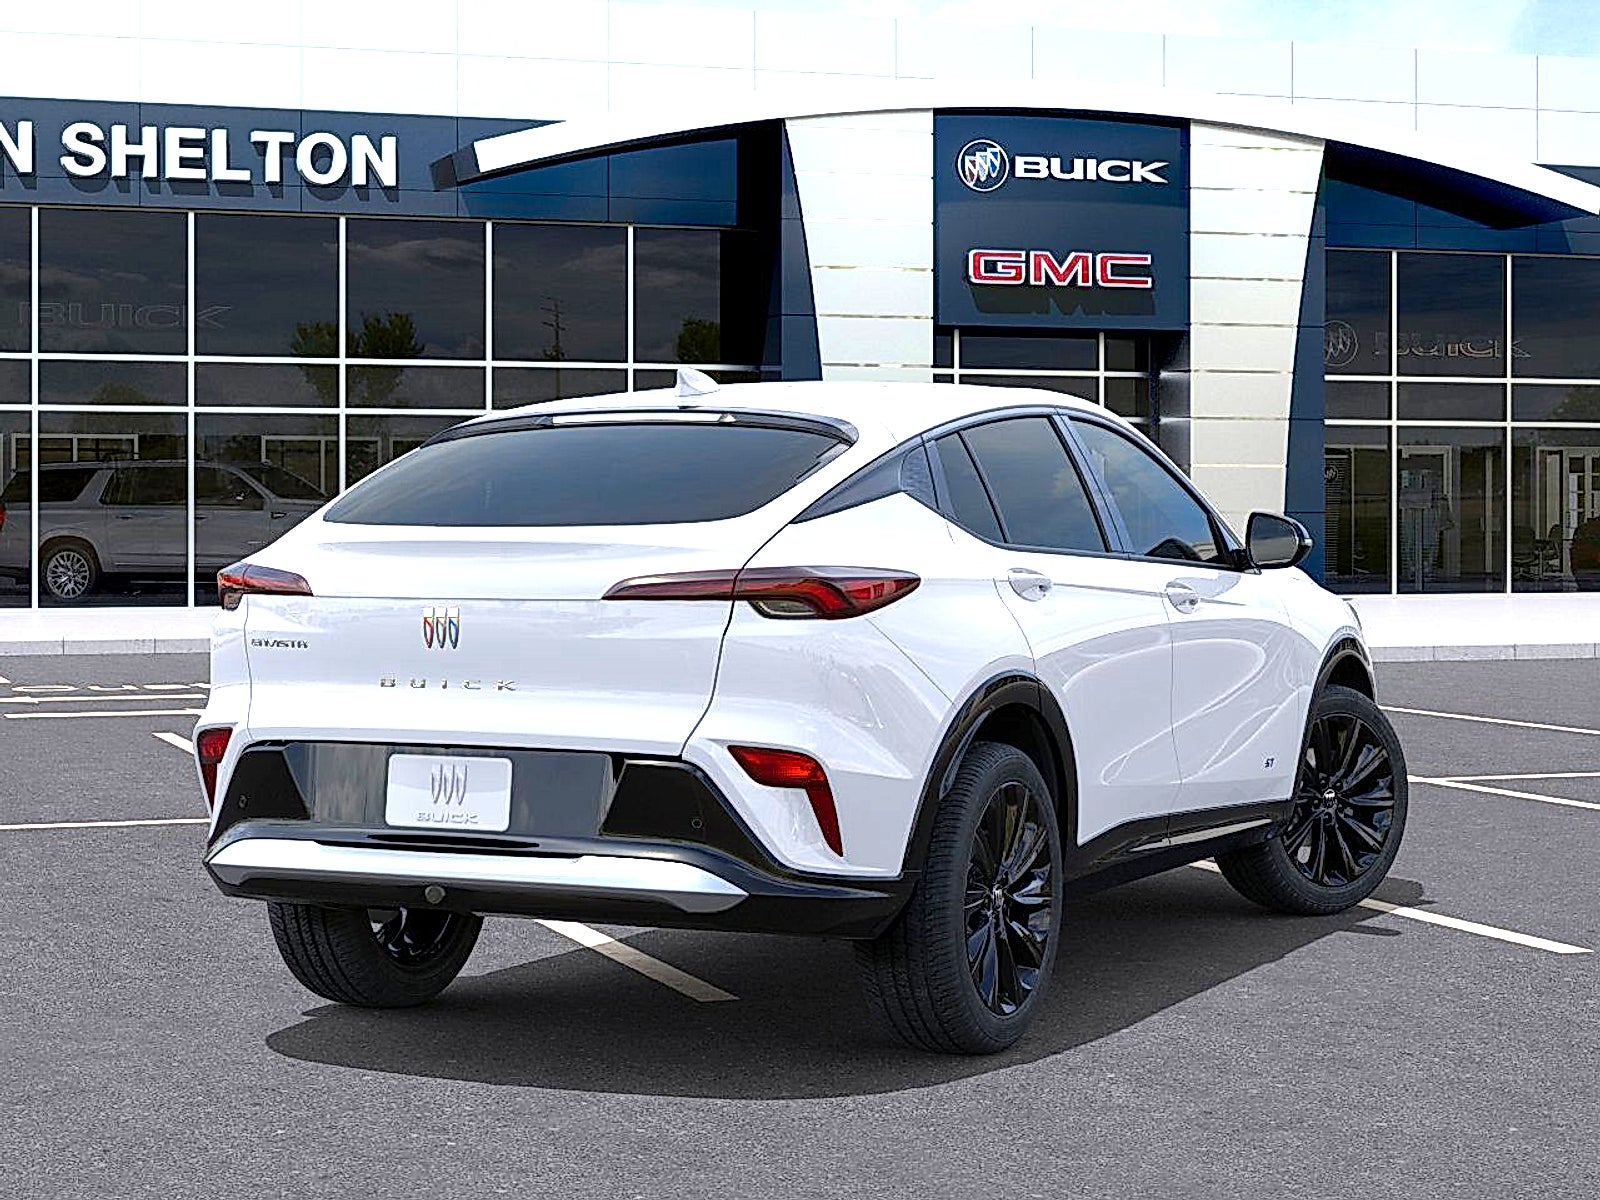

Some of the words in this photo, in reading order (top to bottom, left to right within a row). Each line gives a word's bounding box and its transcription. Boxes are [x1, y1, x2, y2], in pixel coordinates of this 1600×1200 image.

[60, 121, 398, 187] SHELTON
[1014, 155, 1170, 184] BUICK
[968, 249, 1153, 289] GMC
[380, 673, 517, 691] BUICK
[416, 812, 479, 825] BUICK
